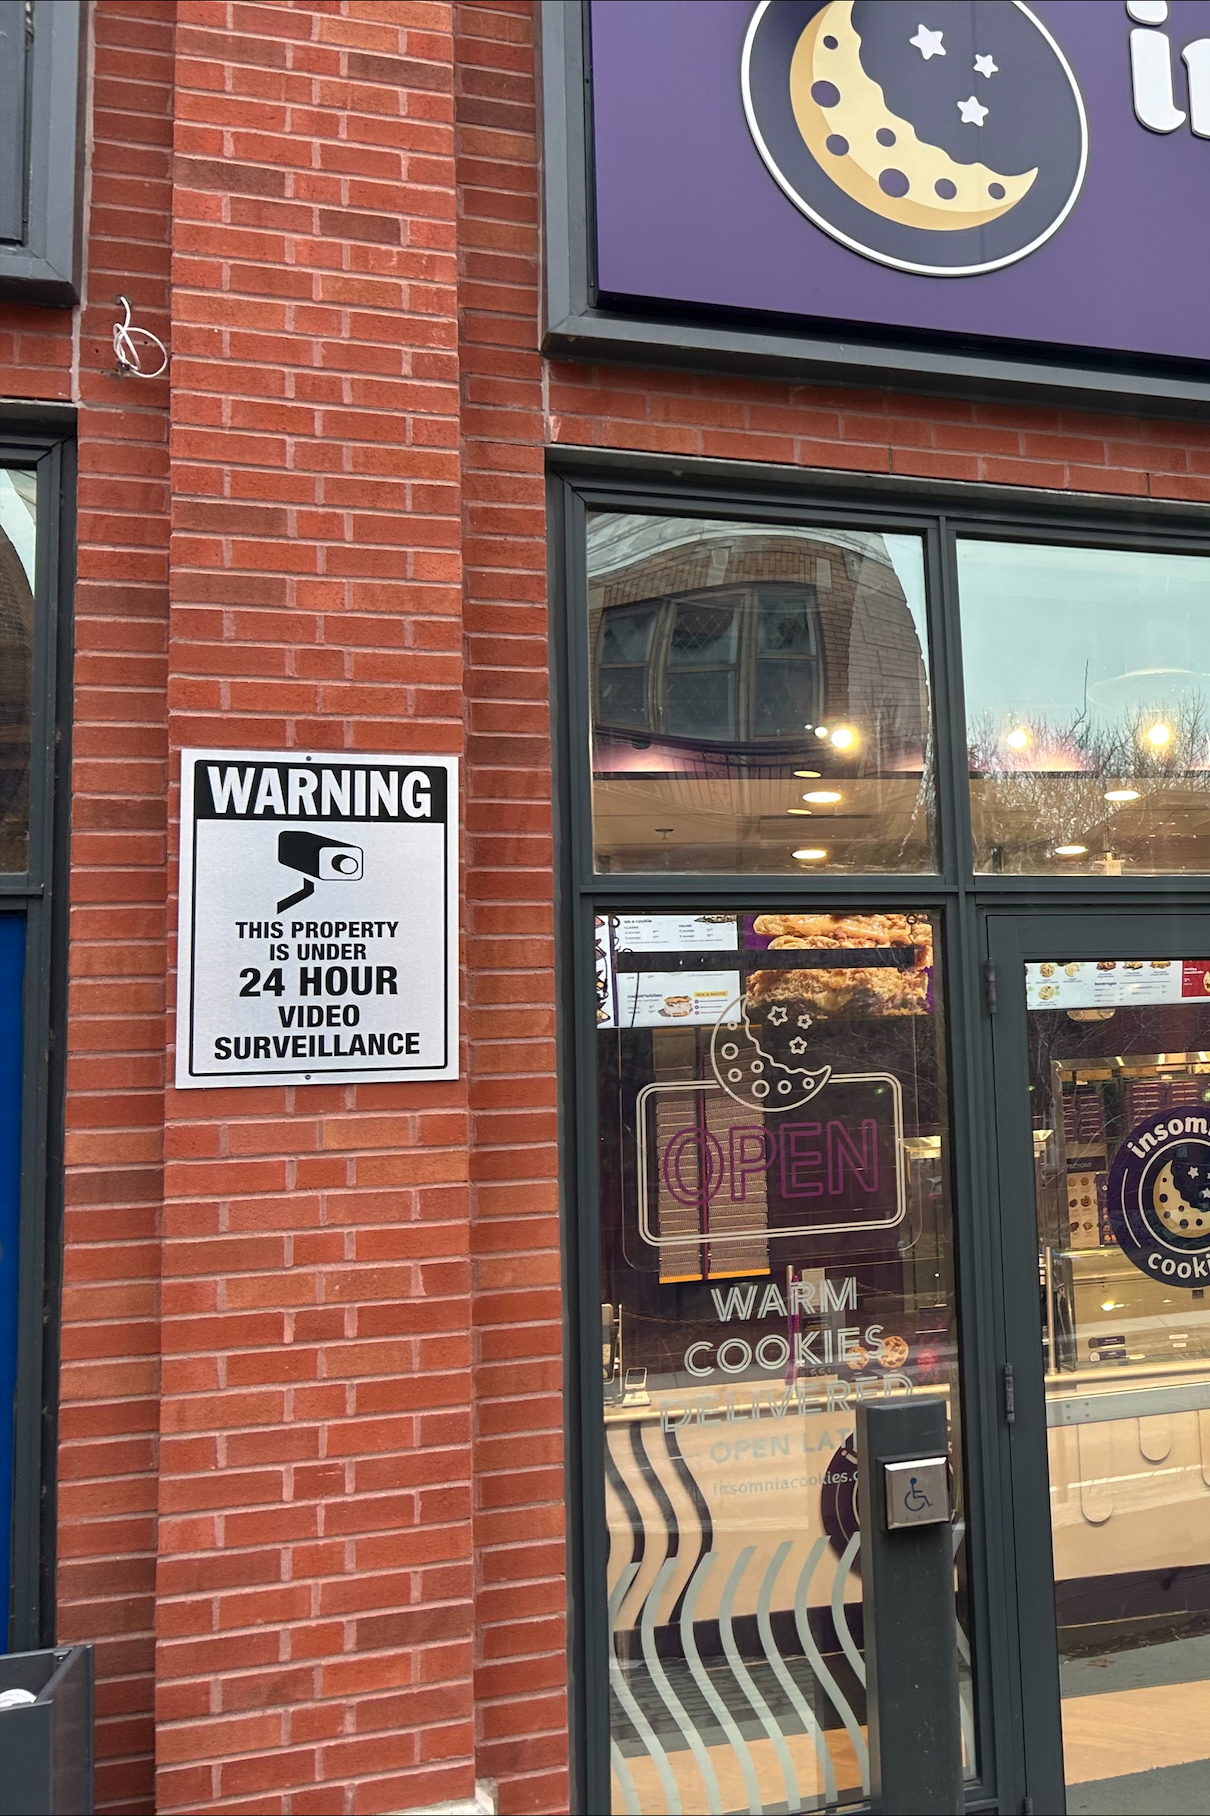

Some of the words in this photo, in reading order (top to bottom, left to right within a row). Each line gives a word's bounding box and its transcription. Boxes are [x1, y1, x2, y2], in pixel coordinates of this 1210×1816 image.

[207, 765, 432, 818] WARNING
[235, 921, 284, 939] THIS
[291, 921, 399, 939] PROPERTY
[269, 943, 290, 961] IS
[297, 943, 367, 960] UNDER
[239, 967, 285, 997] 24
[300, 965, 398, 996] HOUR
[278, 1004, 360, 1028] VIDEO
[214, 1032, 420, 1060] SURVEILLANCE
[663, 1118, 879, 1206] OPEN
[710, 1276, 858, 1323] WARM
[684, 1324, 885, 1377] COOKIES
[658, 1373, 914, 1433] DELIVERED
[709, 1434, 790, 1464] OPEN
[802, 1427, 857, 1453] LAT
